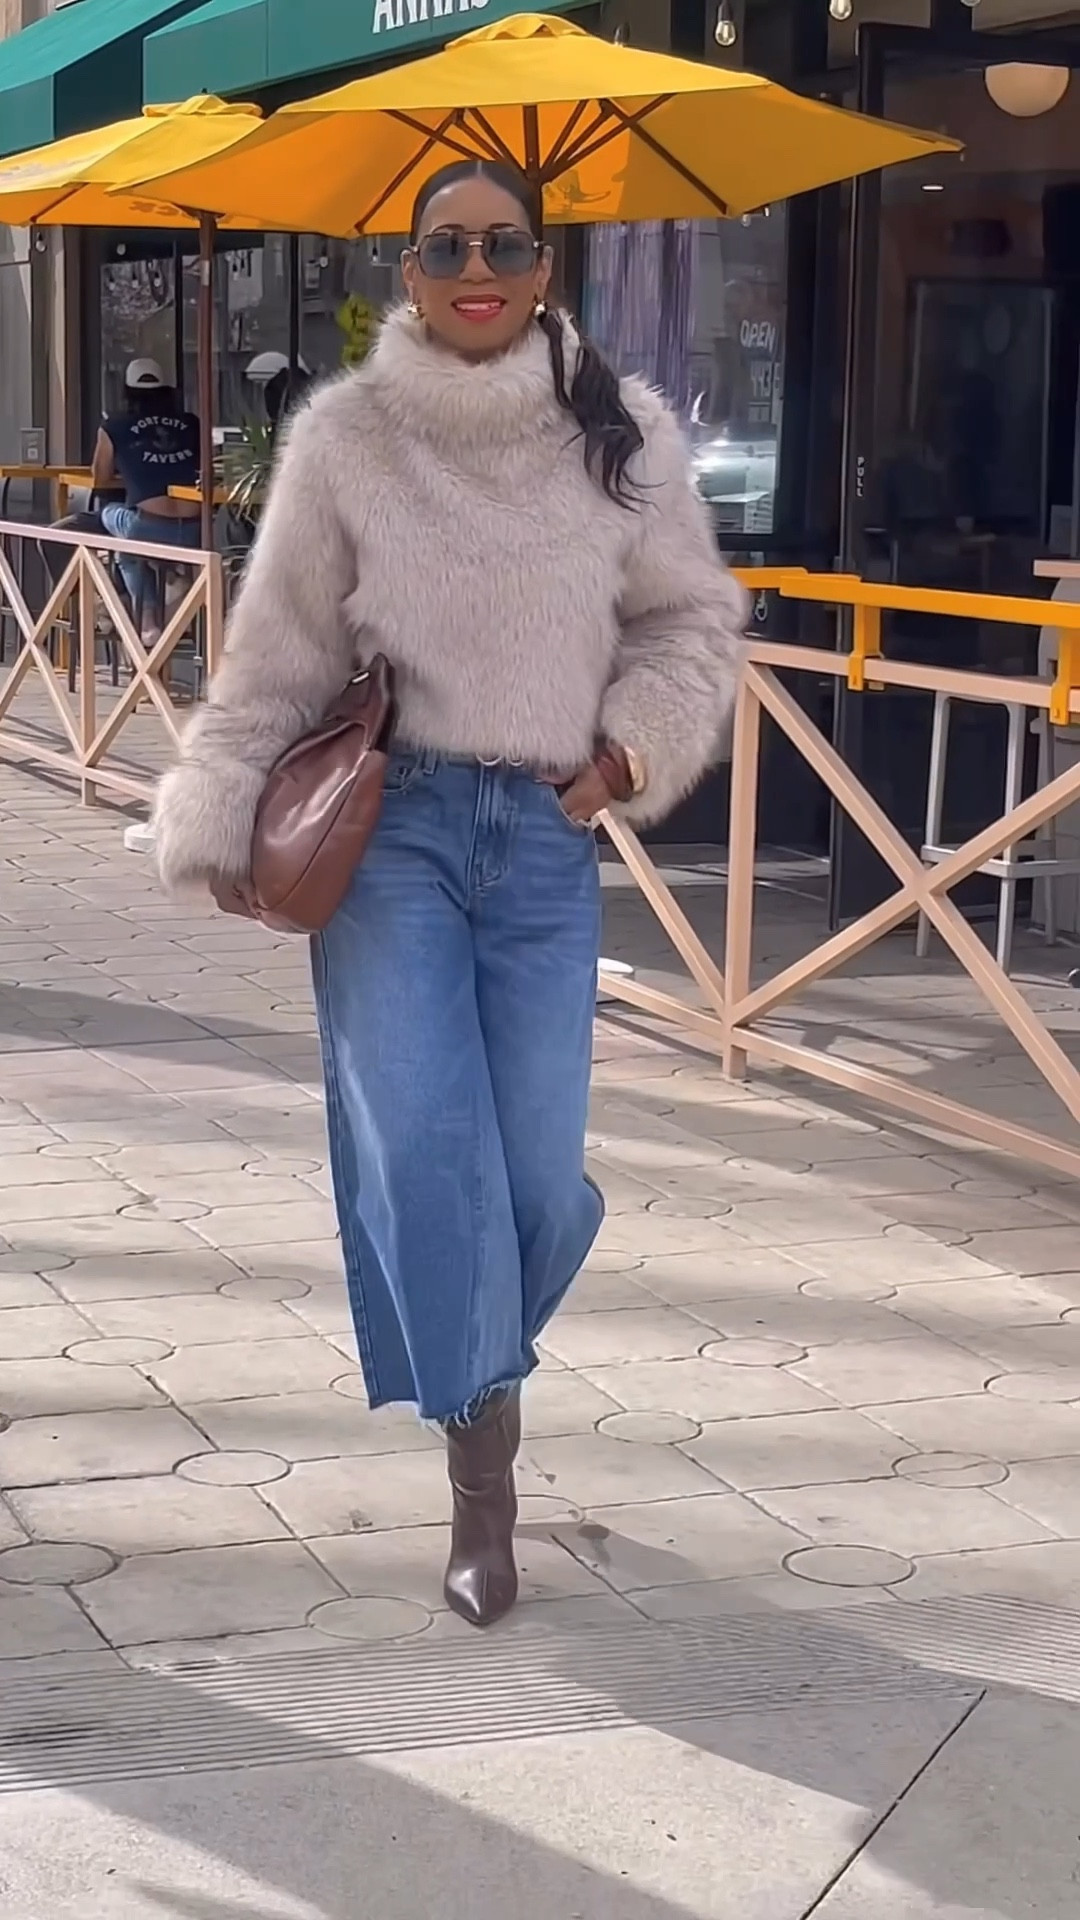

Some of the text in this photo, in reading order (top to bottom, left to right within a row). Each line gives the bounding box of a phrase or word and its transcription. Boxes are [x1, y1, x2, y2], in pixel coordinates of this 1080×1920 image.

[740, 319, 776, 353] OPEN
[130, 416, 189, 434] PORT CITY
[142, 448, 194, 464] TAVERN
[857, 456, 865, 497] PULL
